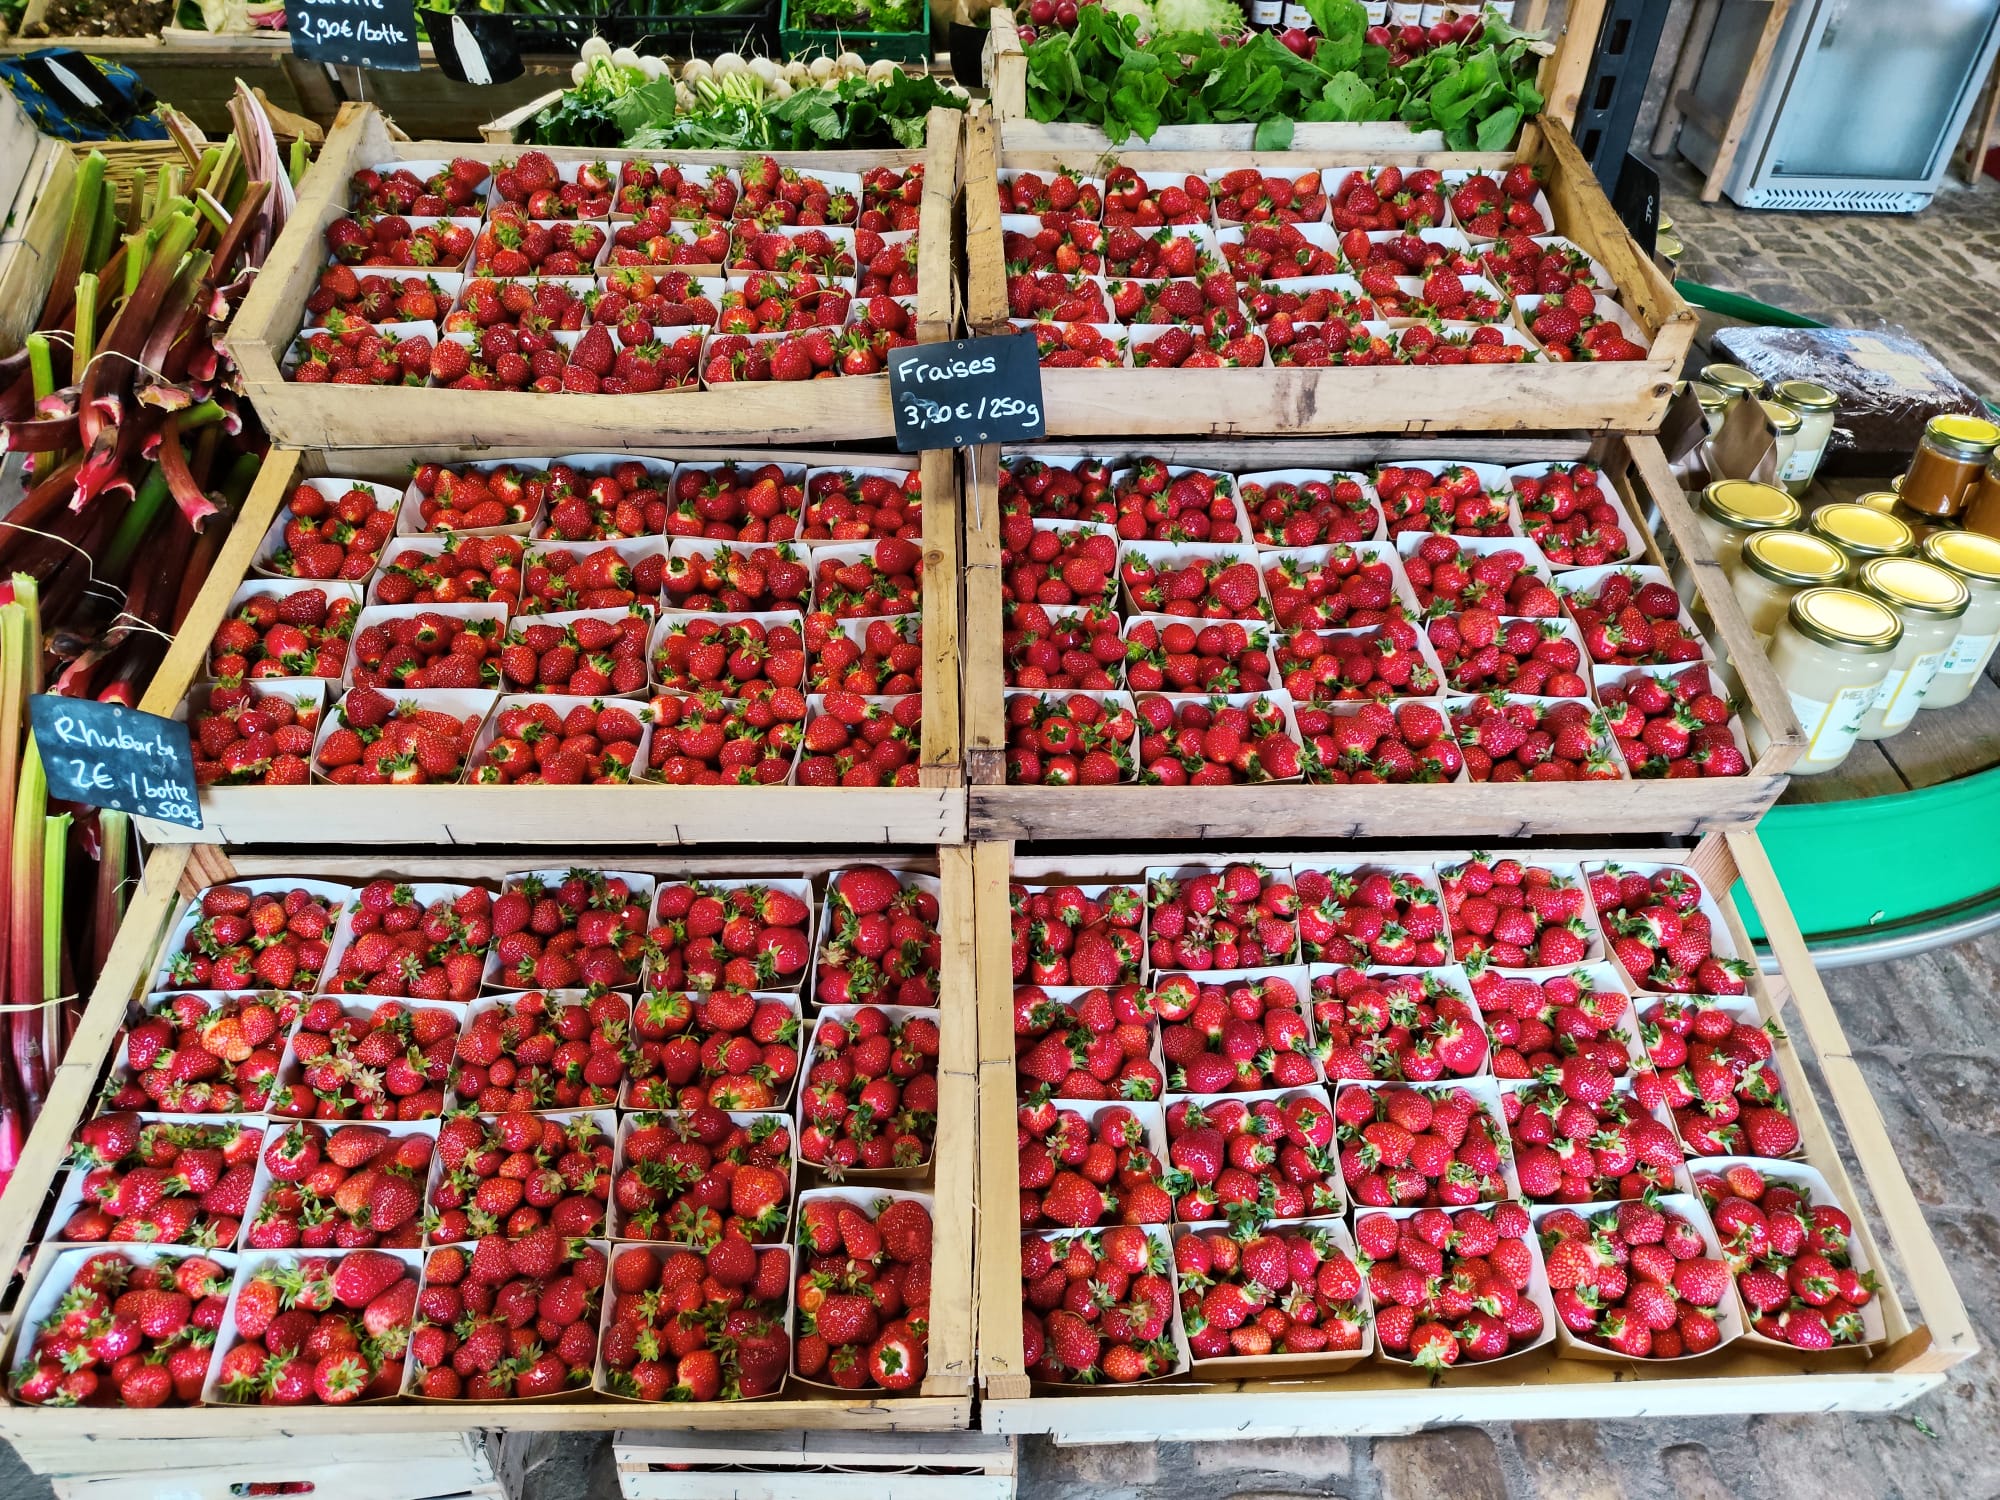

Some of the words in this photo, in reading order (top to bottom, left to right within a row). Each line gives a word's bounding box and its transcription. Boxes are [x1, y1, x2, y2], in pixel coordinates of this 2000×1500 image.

[898, 356, 996, 384] Fraises
[54, 716, 178, 760] Rhubarbe
[70, 759, 115, 789] 2€
[156, 801, 203, 828] 500g
